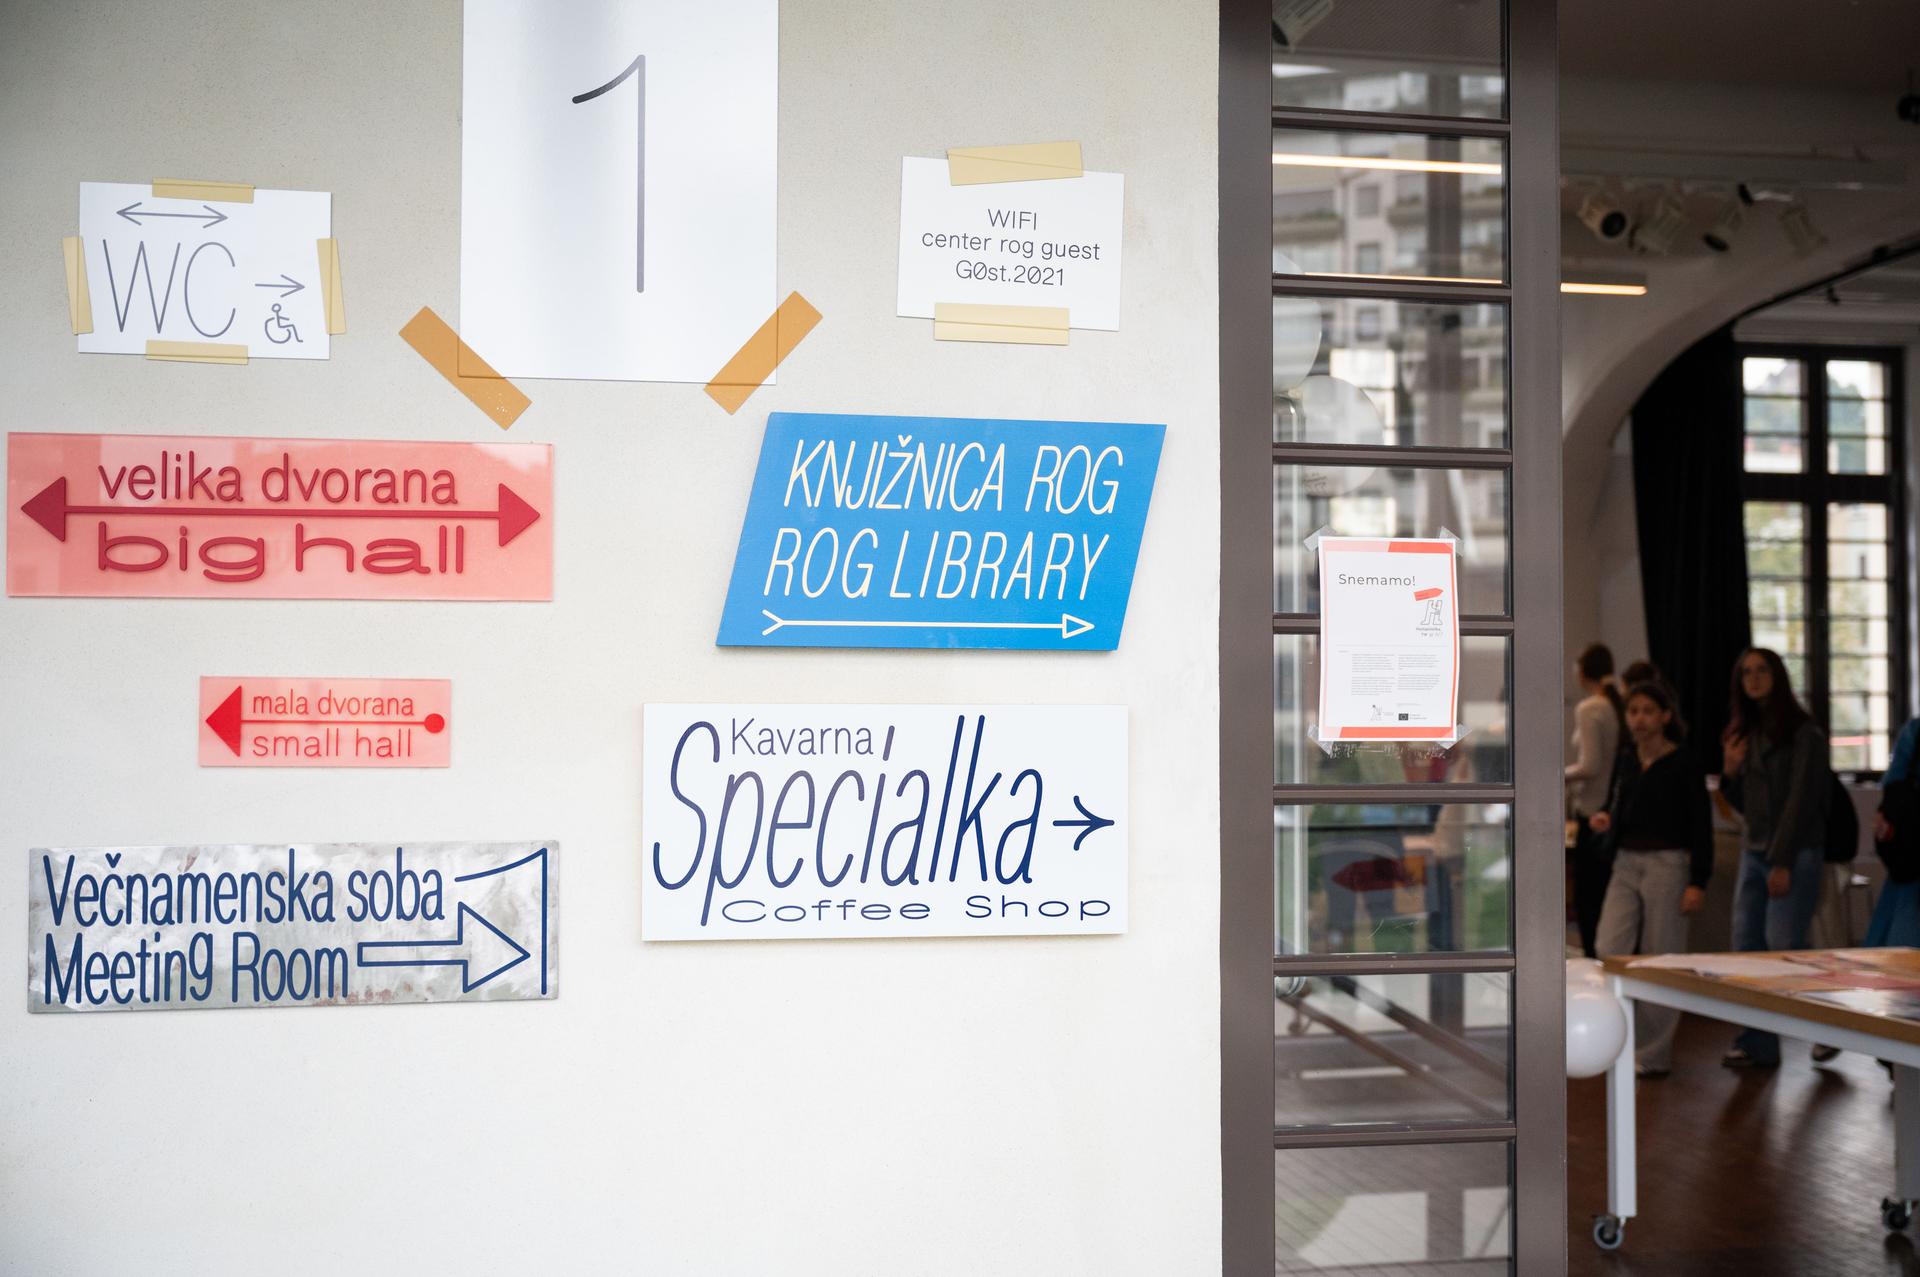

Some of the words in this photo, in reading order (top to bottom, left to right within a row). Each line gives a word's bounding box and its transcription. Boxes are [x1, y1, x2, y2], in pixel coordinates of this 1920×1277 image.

[572, 54, 646, 293] 1
[921, 231, 992, 251] center
[1000, 238, 1034, 259] rog
[1041, 241, 1101, 261] guest
[987, 208, 1038, 231] WIFI
[103, 239, 236, 338] WC
[97, 450, 244, 502] velika
[261, 452, 459, 505] dvorana
[784, 435, 1005, 513] KNJIŽNICA
[1025, 444, 1124, 515] ROG
[98, 521, 265, 583] big
[295, 523, 465, 575] hall
[763, 527, 878, 598] ROG
[889, 530, 1110, 600] LIBRARY
[1338, 573, 1416, 587] Snemamo!
[252, 688, 309, 716] mala
[317, 690, 415, 716] dvorana
[252, 728, 339, 758] small
[354, 729, 412, 758] hall
[732, 718, 874, 756] Kavarna
[653, 714, 1043, 927] Specialka
[42, 847, 335, 927] Večnamenska
[346, 846, 445, 923] soba
[722, 898, 931, 923] Coffee
[965, 895, 1111, 922] Shop
[45, 931, 213, 1004] Meeting
[231, 932, 348, 1004] Room
